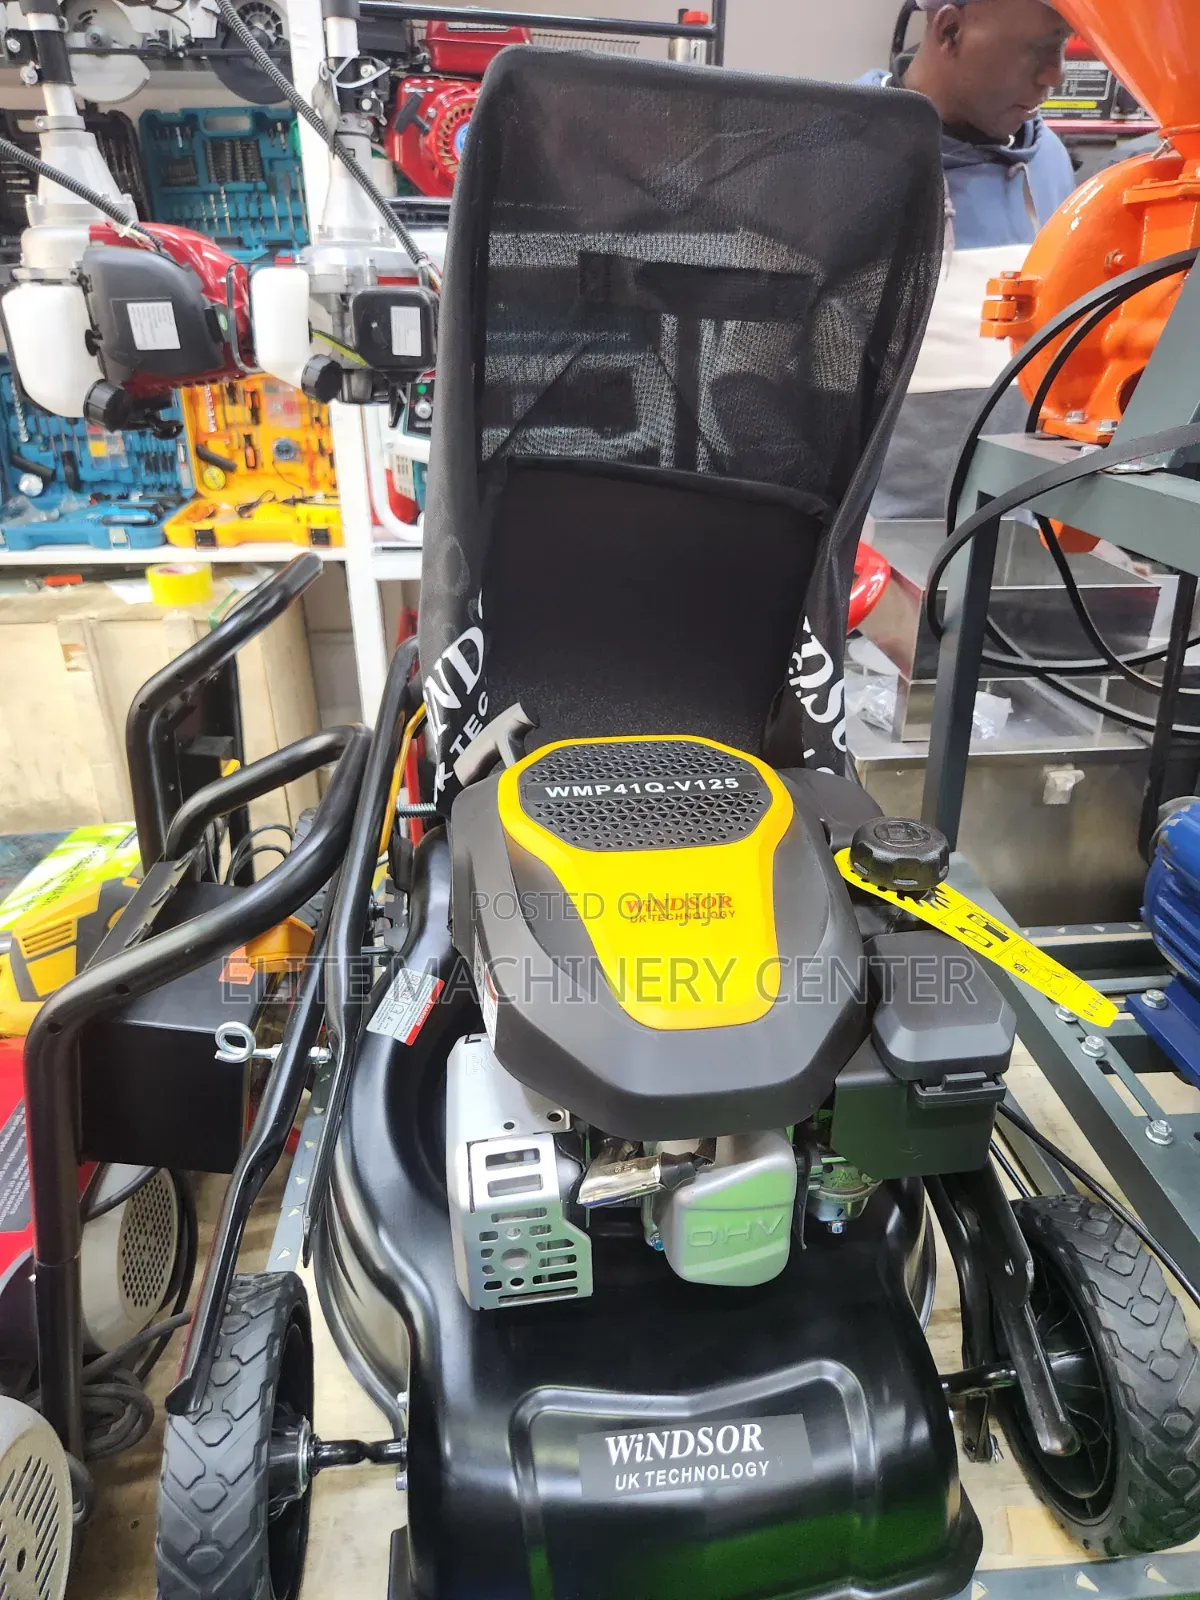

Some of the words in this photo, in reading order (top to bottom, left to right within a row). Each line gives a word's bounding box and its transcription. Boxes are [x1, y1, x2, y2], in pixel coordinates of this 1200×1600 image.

[545, 777, 740, 798] WMP41Q-V125
[630, 915, 647, 924] UK
[651, 910, 736, 922] TECHNOLOGY
[687, 1214, 786, 1248] OHV
[604, 1423, 765, 1467] WiNDSOR
[614, 1472, 641, 1492] UK
[644, 1460, 770, 1488] TECHNOLOGY
